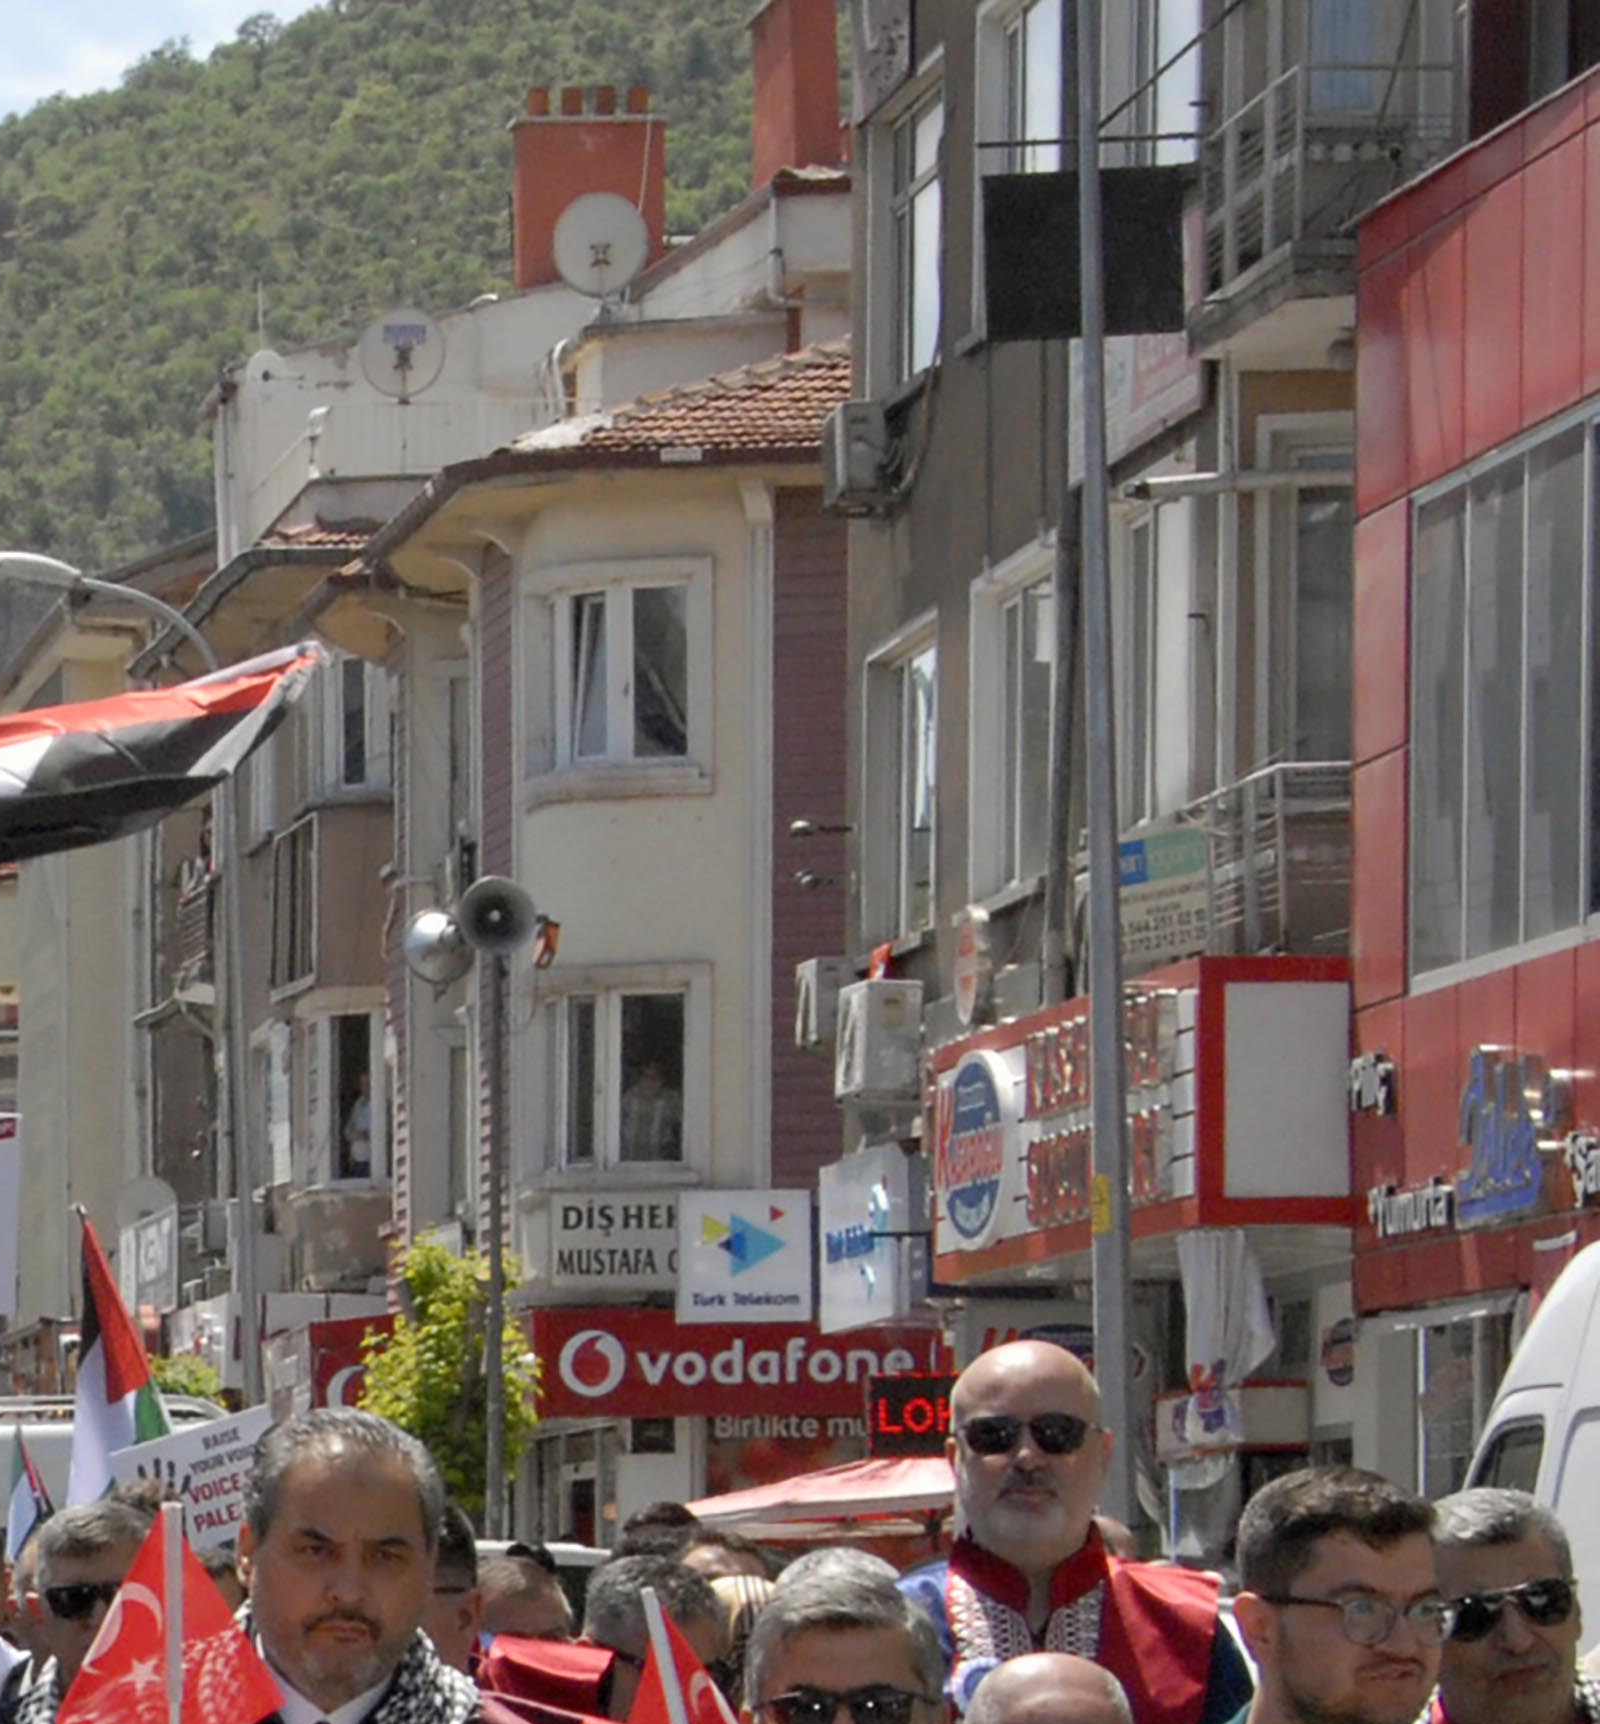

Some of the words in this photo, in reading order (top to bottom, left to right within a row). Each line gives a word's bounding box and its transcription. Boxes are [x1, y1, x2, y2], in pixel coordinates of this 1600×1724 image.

[561, 1199, 615, 1236] DİŞ
[556, 1248, 657, 1276] MUSTAFA
[637, 1338, 915, 1386] vodafone
[714, 1414, 819, 1440] Birlikte
[827, 1419, 869, 1439] mu
[189, 1472, 240, 1504] VOICE
[194, 1503, 240, 1533] PALE
